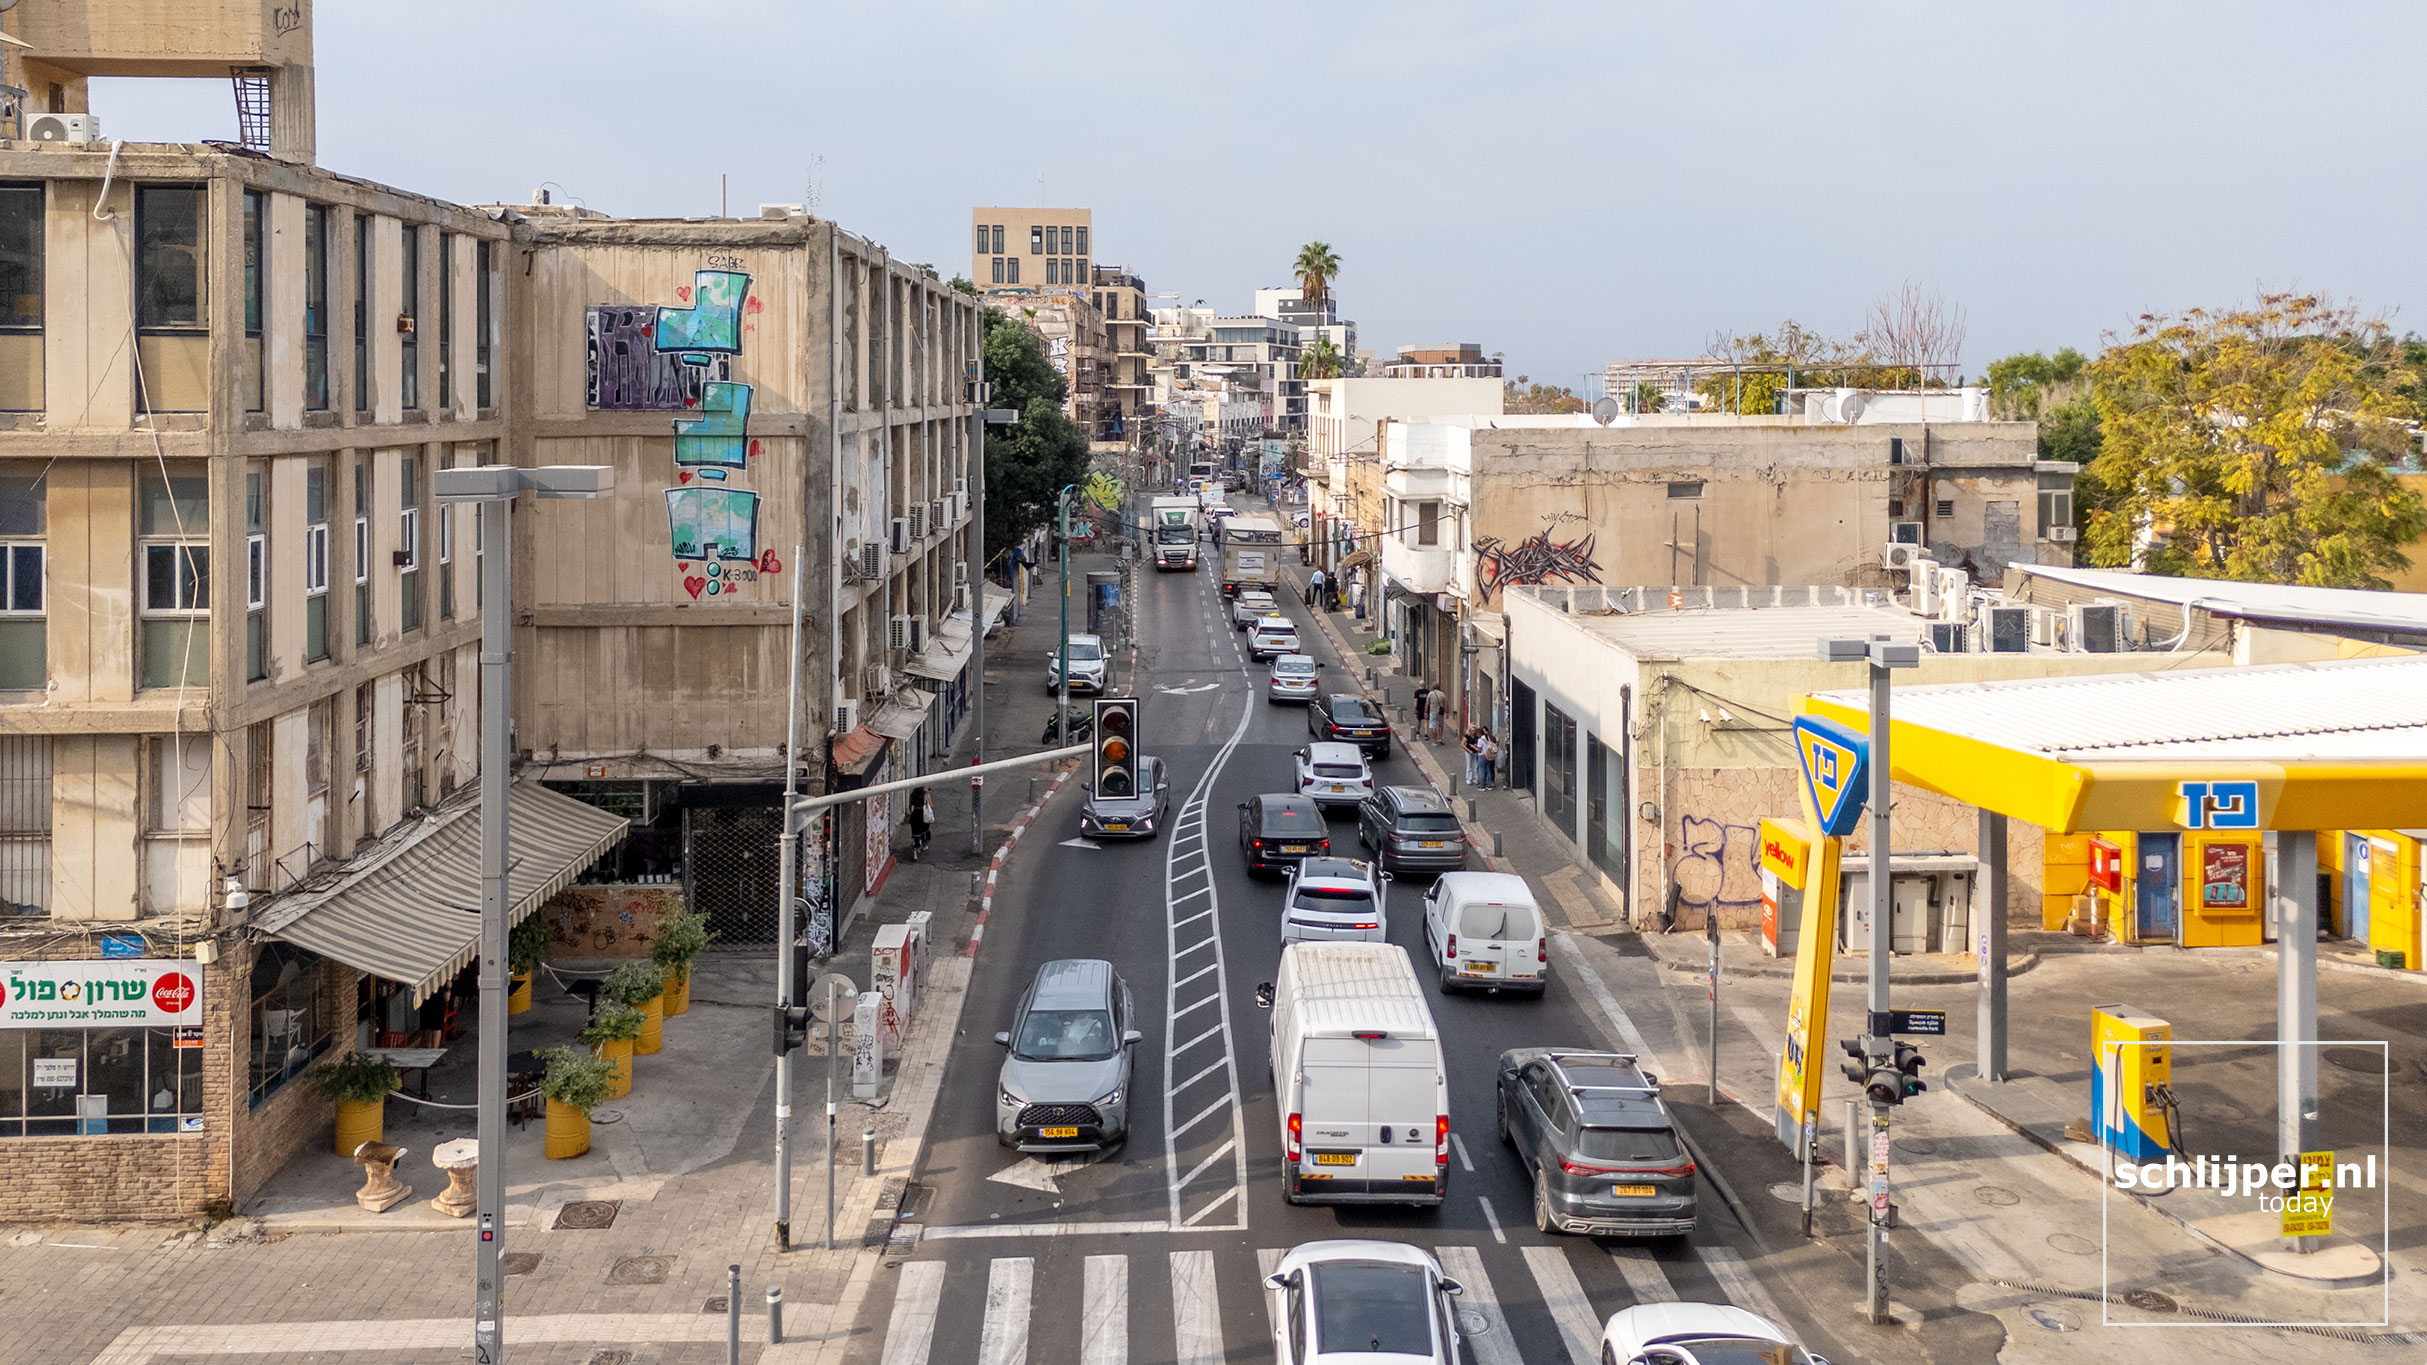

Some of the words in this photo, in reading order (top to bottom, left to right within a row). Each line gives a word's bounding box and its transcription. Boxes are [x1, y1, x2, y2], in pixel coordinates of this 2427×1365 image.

[1811, 742, 1838, 791] פז
[2181, 780, 2259, 829] פז
[1764, 838, 1795, 870] yellow
[10, 976, 56, 1001] פול
[84, 979, 147, 1006] שרון
[47, 1010, 67, 1021] ונתן
[91, 1009, 130, 1020] שהמלך
[130, 1009, 147, 1018] מה
